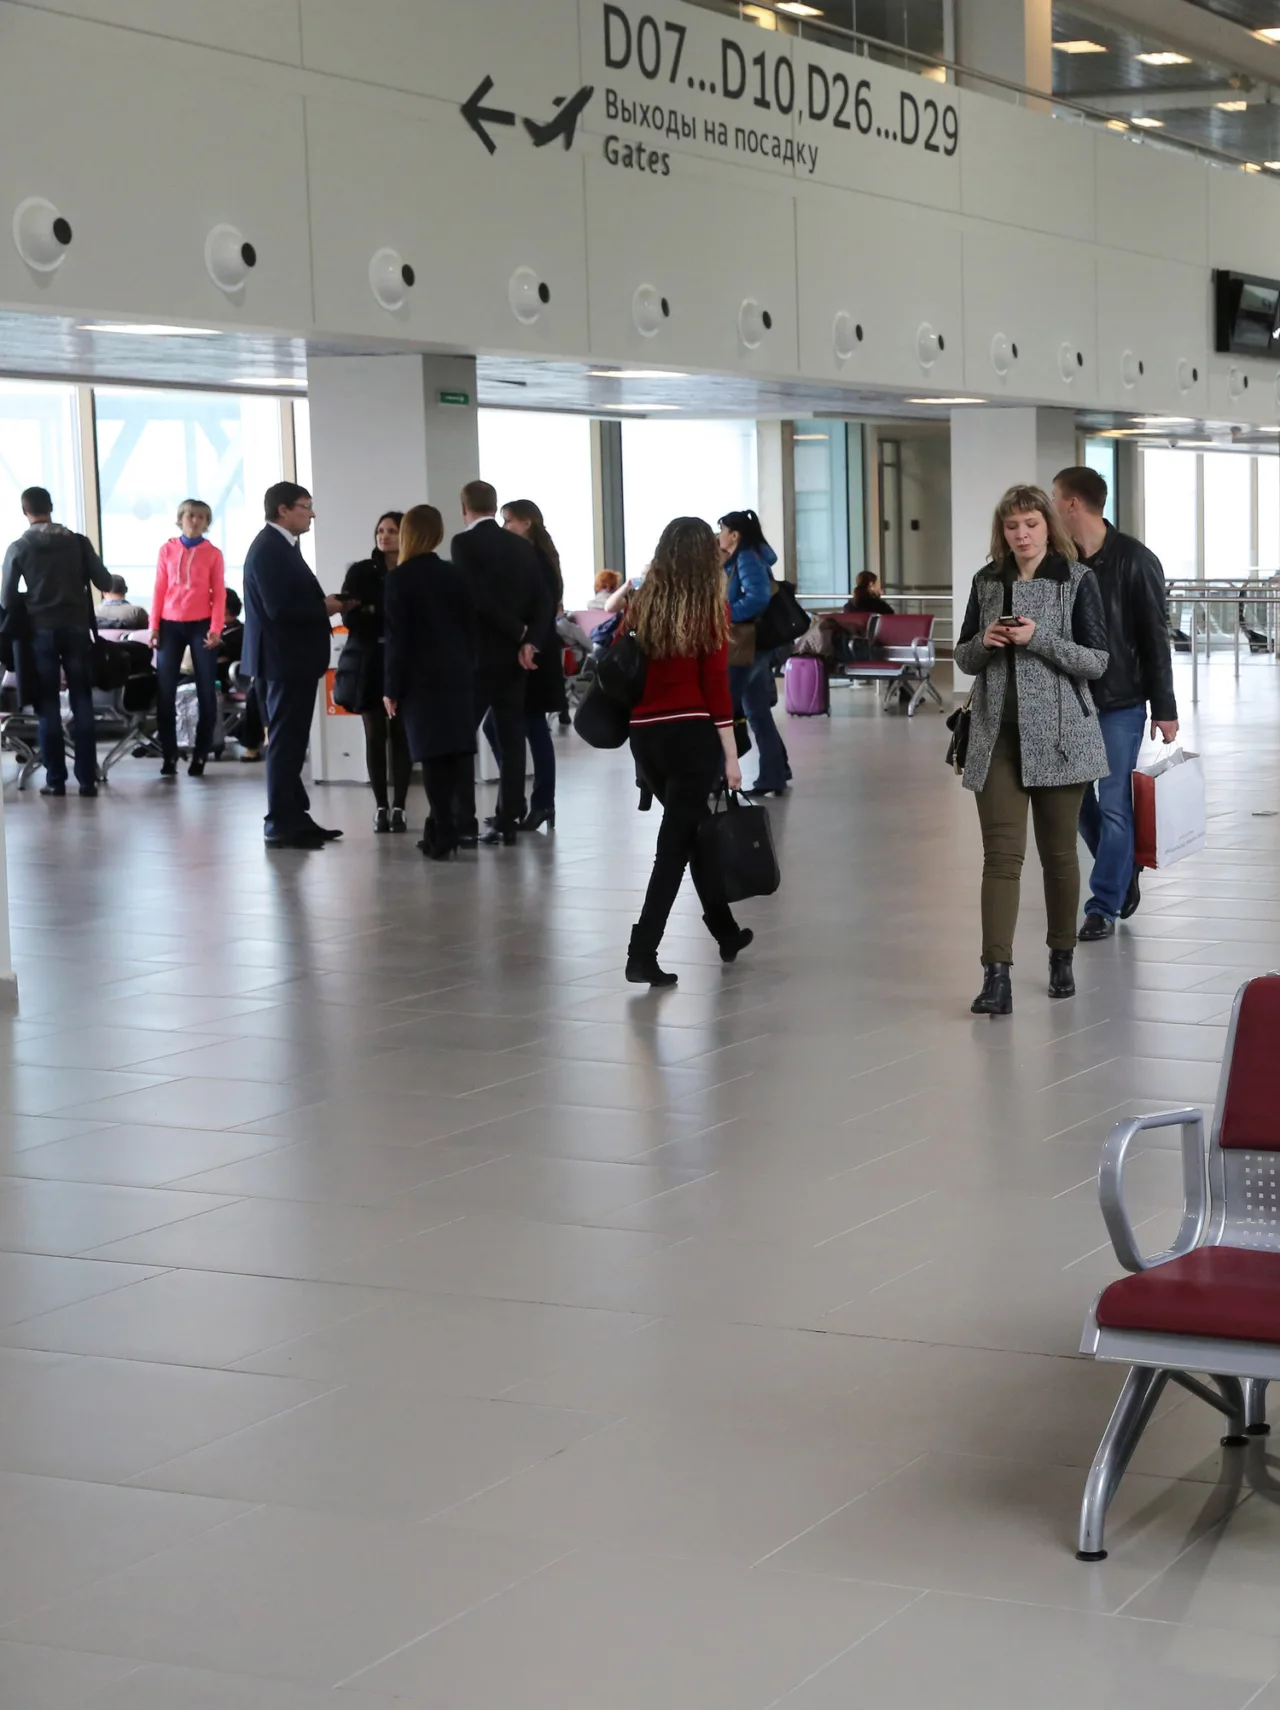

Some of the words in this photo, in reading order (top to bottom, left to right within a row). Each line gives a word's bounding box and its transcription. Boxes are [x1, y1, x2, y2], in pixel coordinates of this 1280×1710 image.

[604, 135, 670, 176] Gates
[605, 88, 697, 140] Выходы
[704, 119, 728, 147] на
[735, 127, 818, 173] посадку
